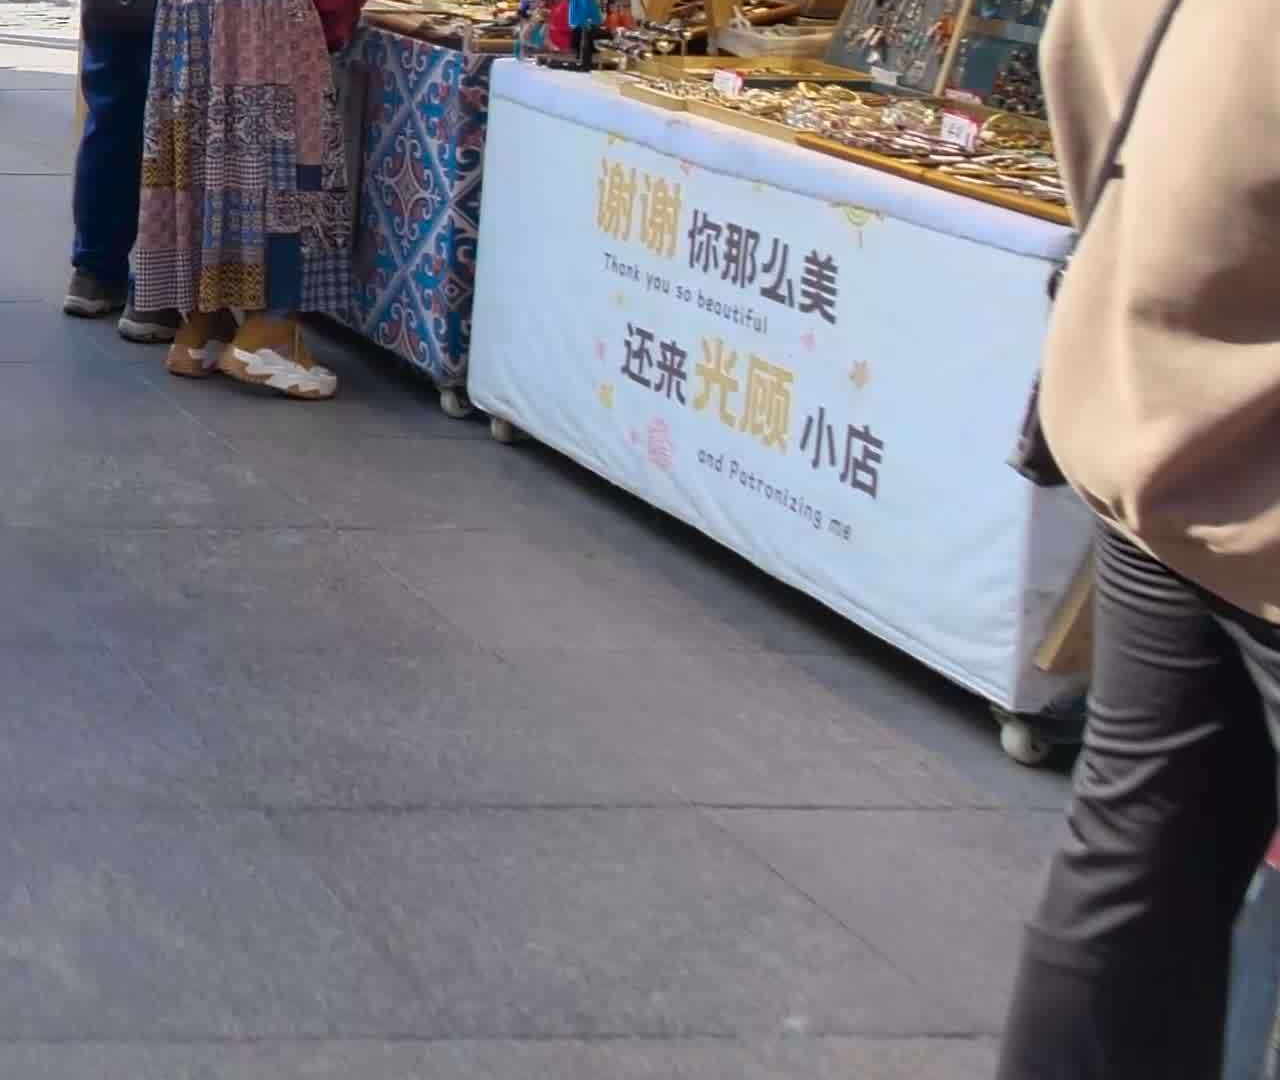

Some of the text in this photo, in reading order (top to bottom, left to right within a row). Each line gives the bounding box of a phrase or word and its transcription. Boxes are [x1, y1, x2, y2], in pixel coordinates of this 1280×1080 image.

[596, 157, 839, 325] 谢谢你那么美
[603, 252, 768, 335] Thank you so beautiful
[620, 322, 884, 501] 还来光顾小店
[697, 447, 853, 541] and Patronizing me
